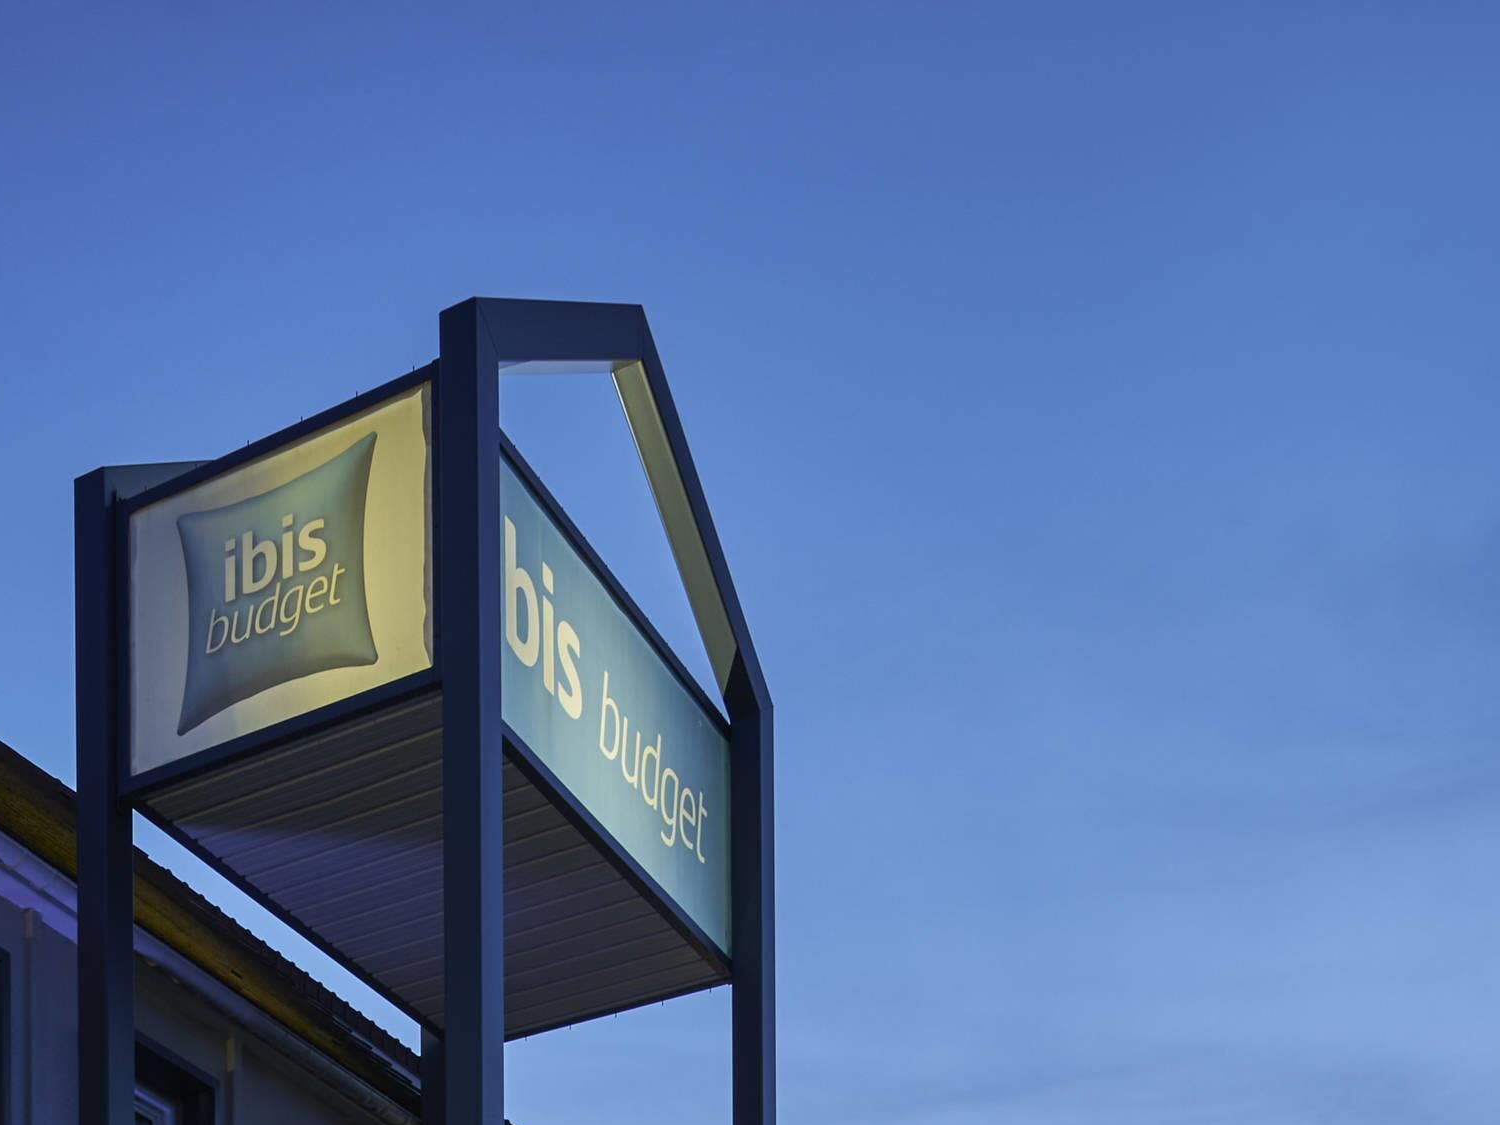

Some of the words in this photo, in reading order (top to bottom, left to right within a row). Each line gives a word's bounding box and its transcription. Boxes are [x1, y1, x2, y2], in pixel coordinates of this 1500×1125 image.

[224, 512, 327, 603] ibis
[205, 562, 346, 655] budget
[504, 514, 583, 721] bis
[599, 670, 708, 864] budget
